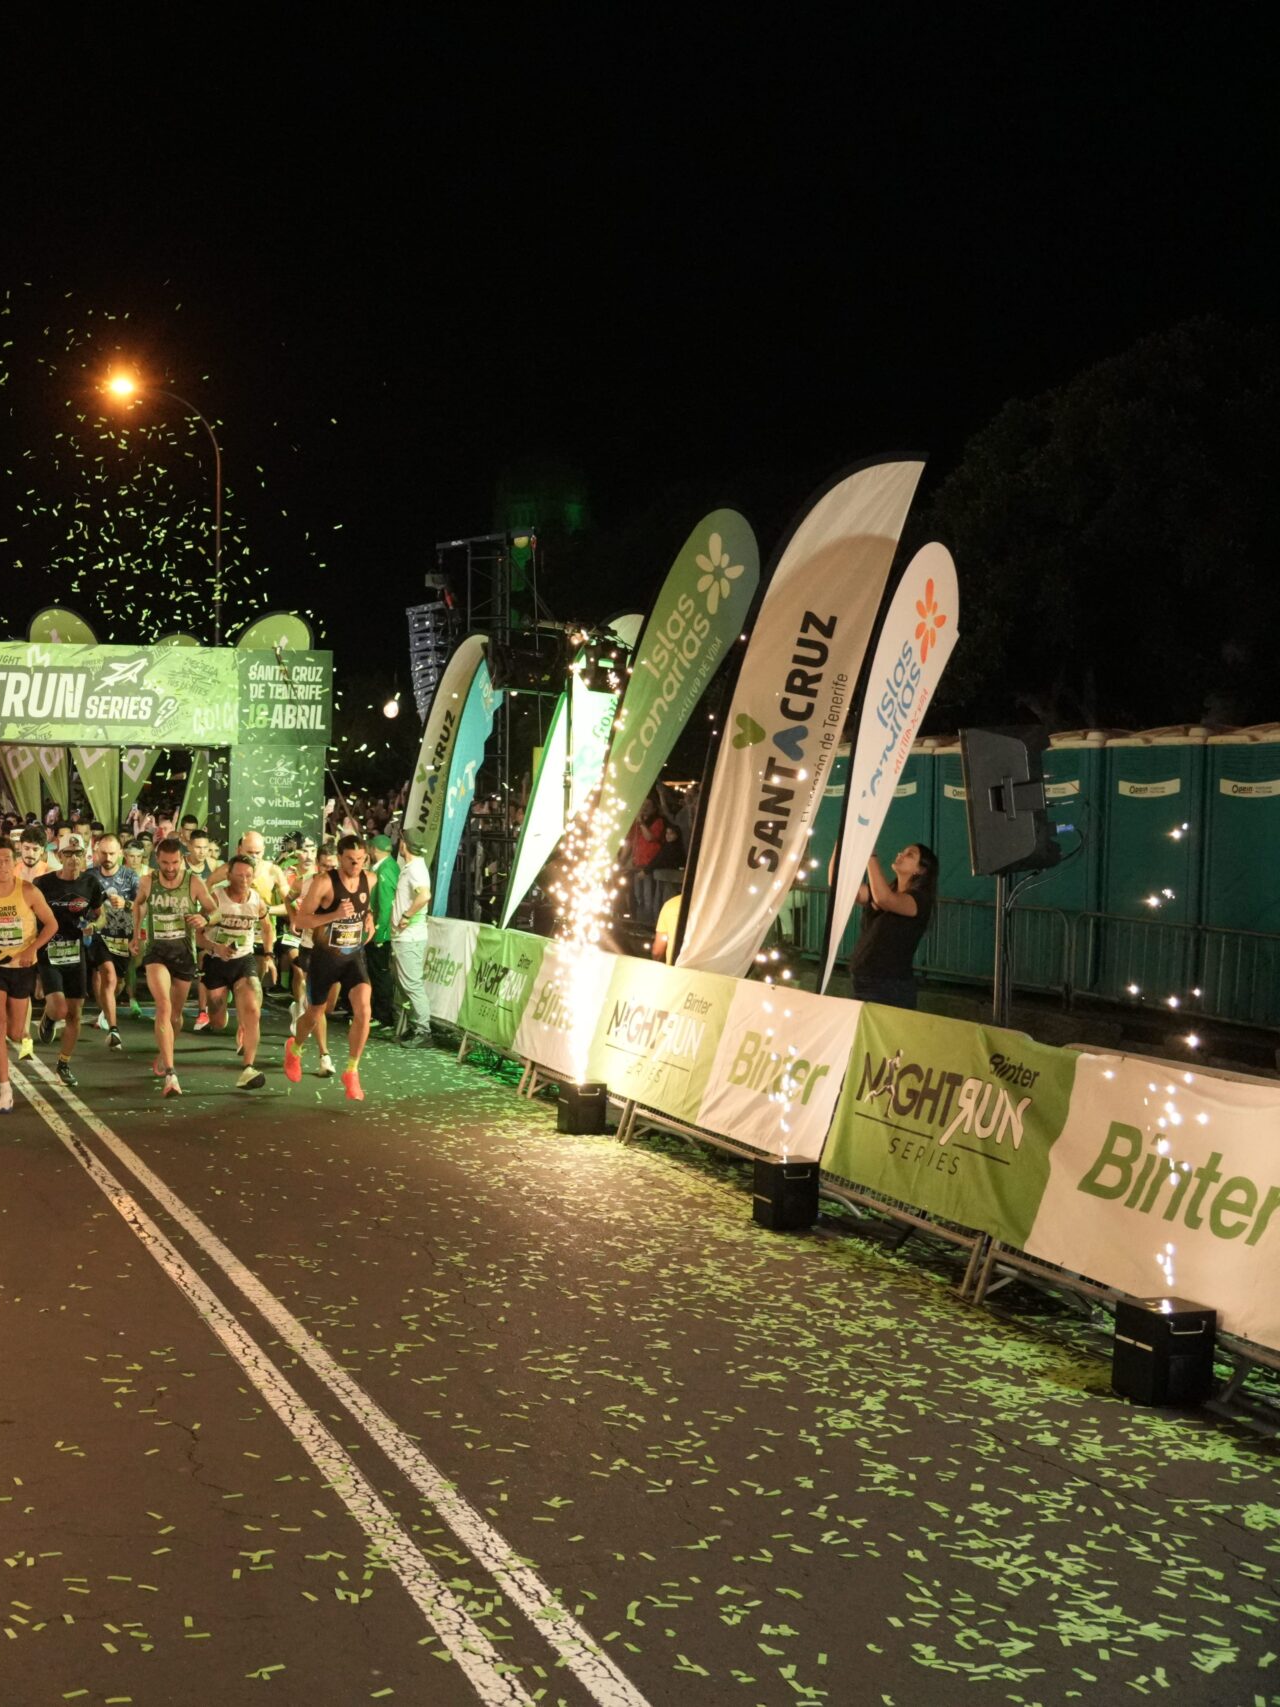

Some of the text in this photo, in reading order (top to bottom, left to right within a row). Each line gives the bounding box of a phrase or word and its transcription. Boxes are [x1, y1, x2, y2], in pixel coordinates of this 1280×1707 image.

[644, 593, 695, 680] Islas
[707, 636, 724, 661] VIDA
[249, 665, 324, 682] SANTA CRUZ
[876, 640, 913, 728] Islas
[85, 695, 152, 720] SERIES
[250, 683, 321, 700] DE TENERIFE
[624, 613, 710, 774] Canarias
[823, 672, 848, 729] Tenerife
[270, 703, 326, 730] ABRIL
[819, 732, 836, 750] de
[269, 777, 292, 786] CICAR
[1232, 784, 1253, 794] Opein
[267, 797, 301, 808] vithas
[264, 836, 284, 845] OWE
[414, 947, 463, 988] Binter
[683, 992, 713, 1015] Binter
[606, 998, 706, 1062] NIGHTRUN
[728, 1030, 831, 1106] Binter
[989, 1052, 1040, 1090] Binter
[856, 1049, 1032, 1151] NIGHTRUN
[887, 1136, 961, 1176] SERIES
[1077, 1120, 1280, 1247] Binter
